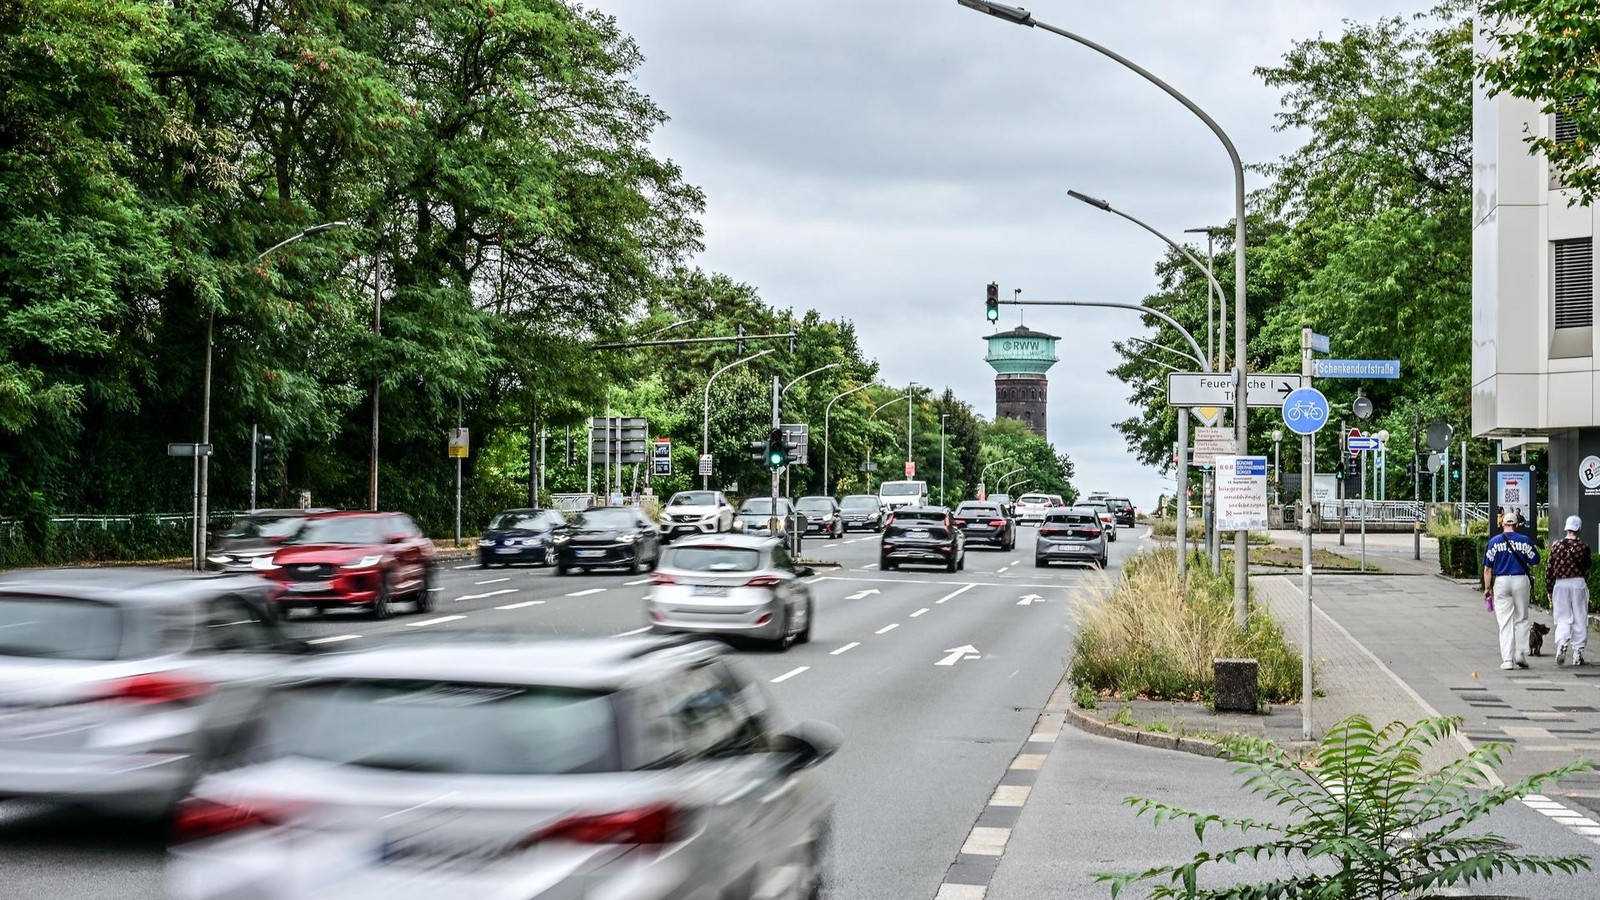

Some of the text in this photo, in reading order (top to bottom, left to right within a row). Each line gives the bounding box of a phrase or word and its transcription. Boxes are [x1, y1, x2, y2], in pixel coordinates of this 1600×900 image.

[1013, 341, 1039, 350] RWW
[1319, 363, 1394, 374] Schenkendorfstraße
[1200, 379, 1266, 389] Feuerche
